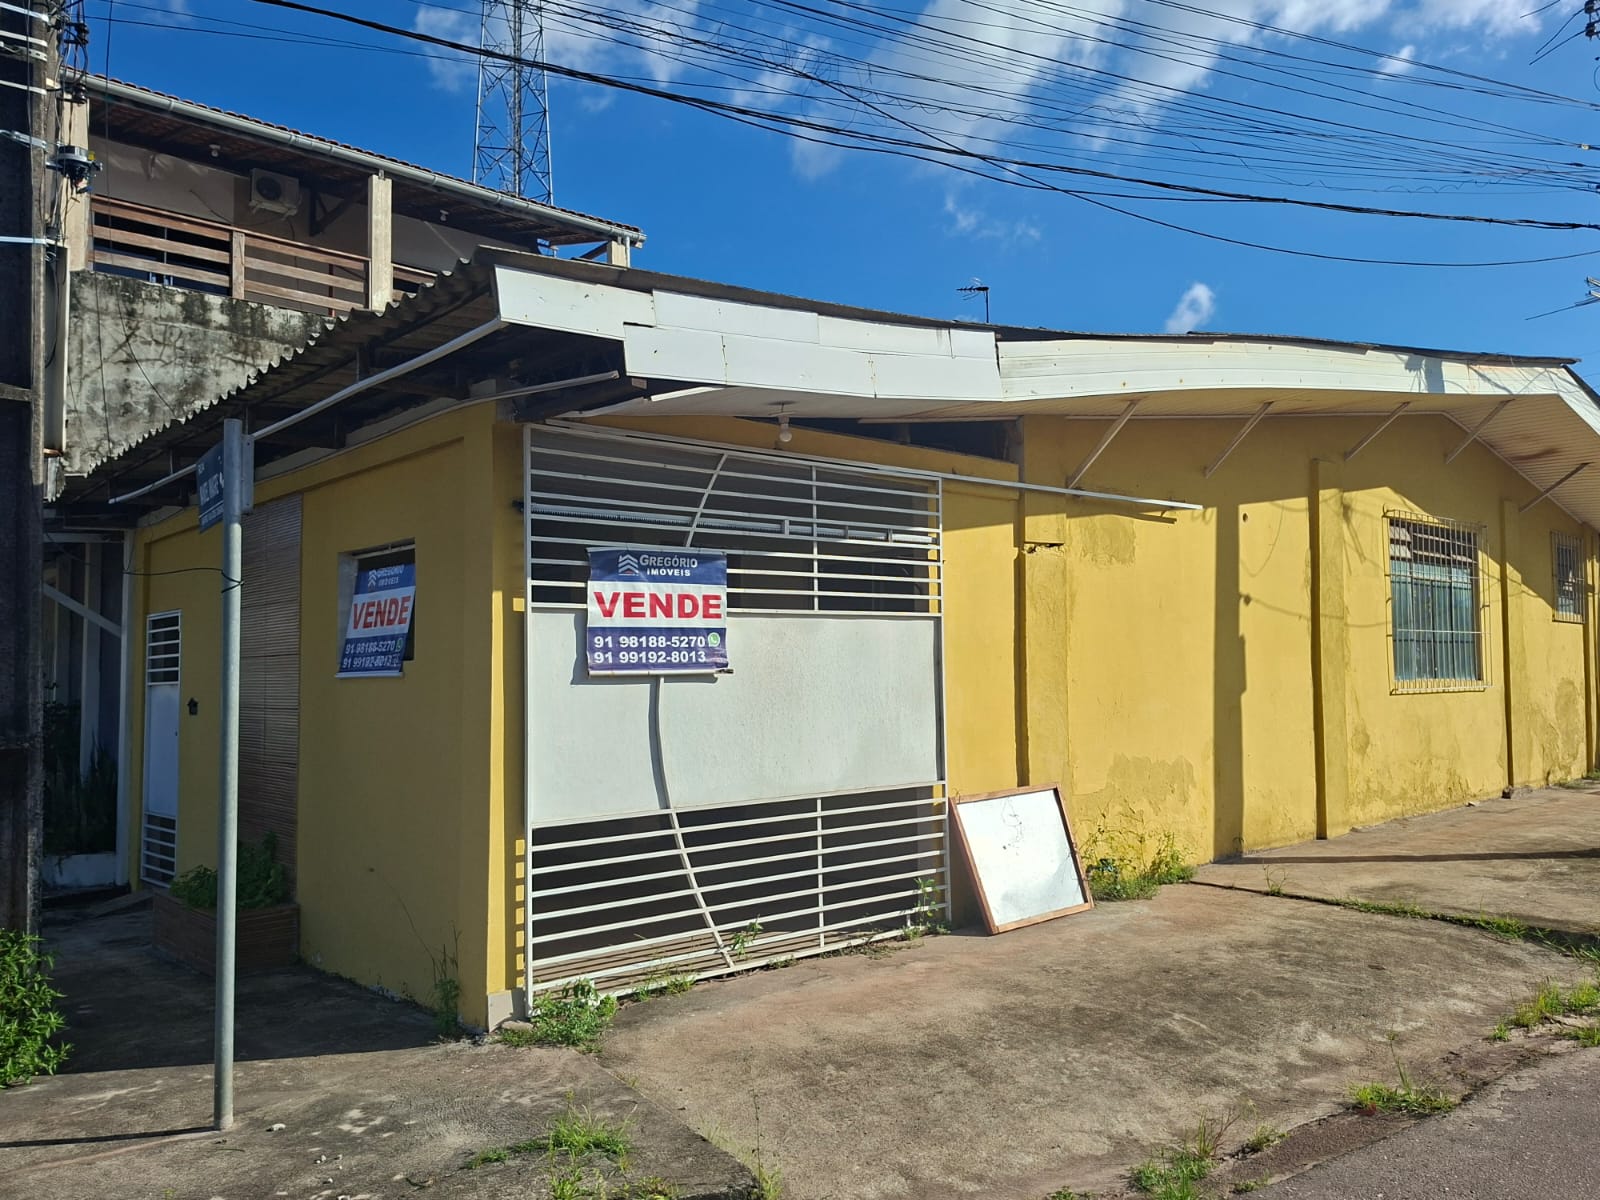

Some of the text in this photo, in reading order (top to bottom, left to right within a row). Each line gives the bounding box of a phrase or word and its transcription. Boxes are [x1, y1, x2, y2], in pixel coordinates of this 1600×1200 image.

[640, 554, 698, 568] GREGÓRIO
[646, 567, 691, 577] IMÓVEIS
[593, 591, 722, 619] VENDE
[353, 595, 411, 629] VENDE
[594, 635, 706, 648] 91 98188-5270
[594, 651, 706, 664] 91 99192-8013
